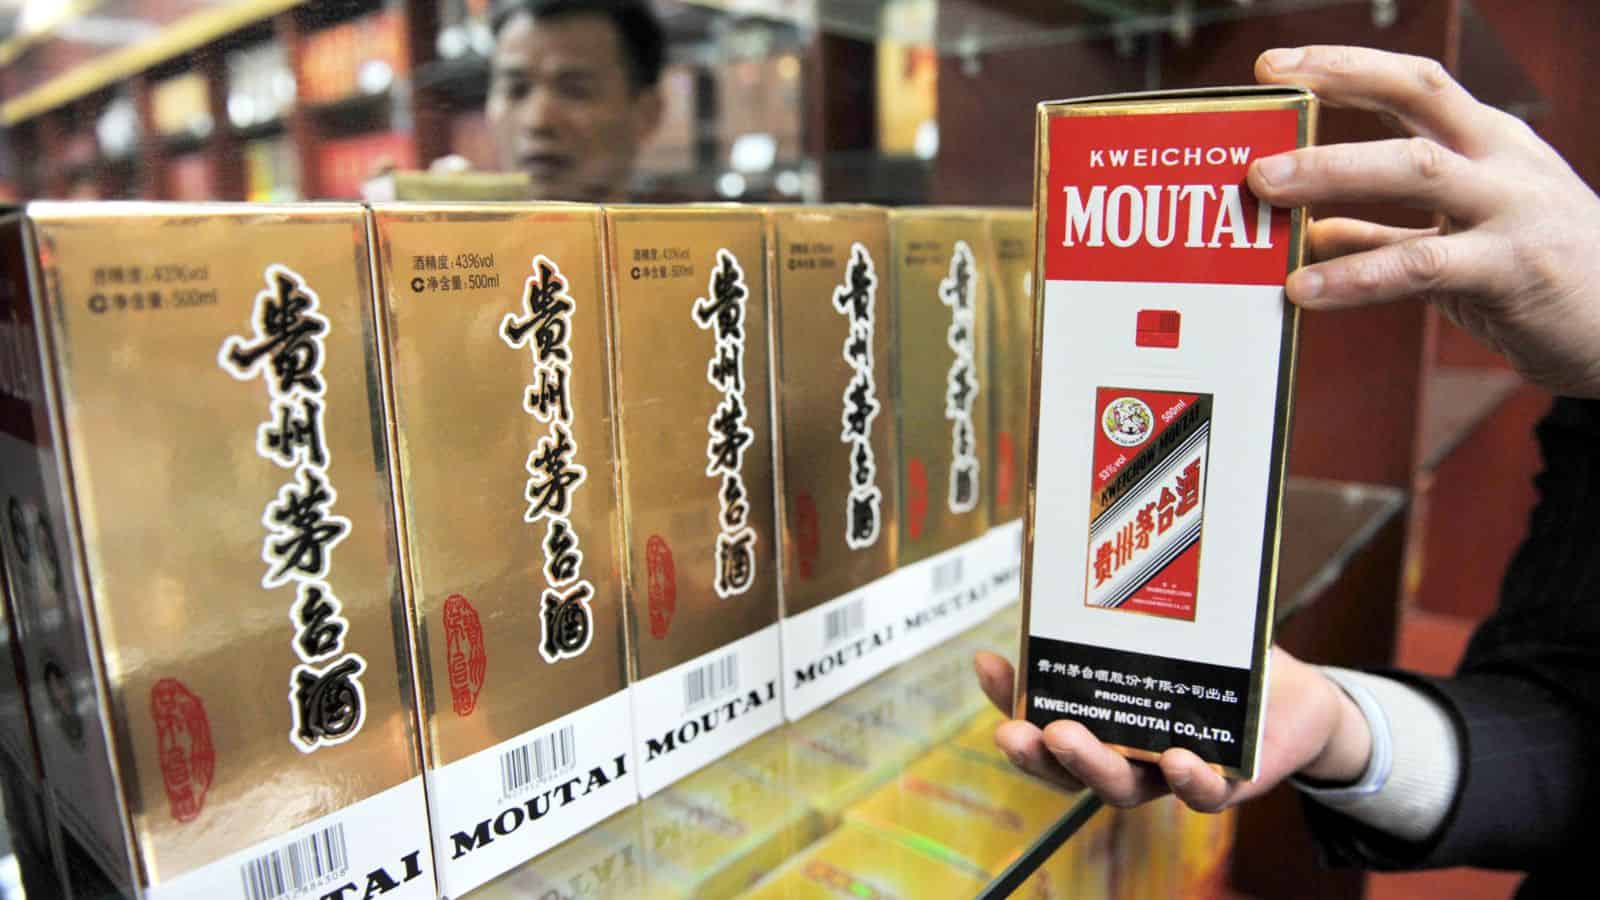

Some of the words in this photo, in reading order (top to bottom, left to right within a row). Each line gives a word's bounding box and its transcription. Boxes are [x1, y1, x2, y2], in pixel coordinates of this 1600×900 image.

[1090, 147, 1251, 168] KWEICHOW
[1062, 184, 1274, 248] MOUTAI
[1161, 399, 1187, 423] 500ml
[793, 626, 893, 689] MOUTAI
[645, 680, 777, 763] MOUTAI
[1033, 696, 1112, 721] KWEICHOW
[1114, 711, 1170, 732] MOUTAI
[1095, 689, 1151, 708] PRODUCE
[1154, 700, 1172, 711] OF
[450, 754, 627, 860] MOUTAI
